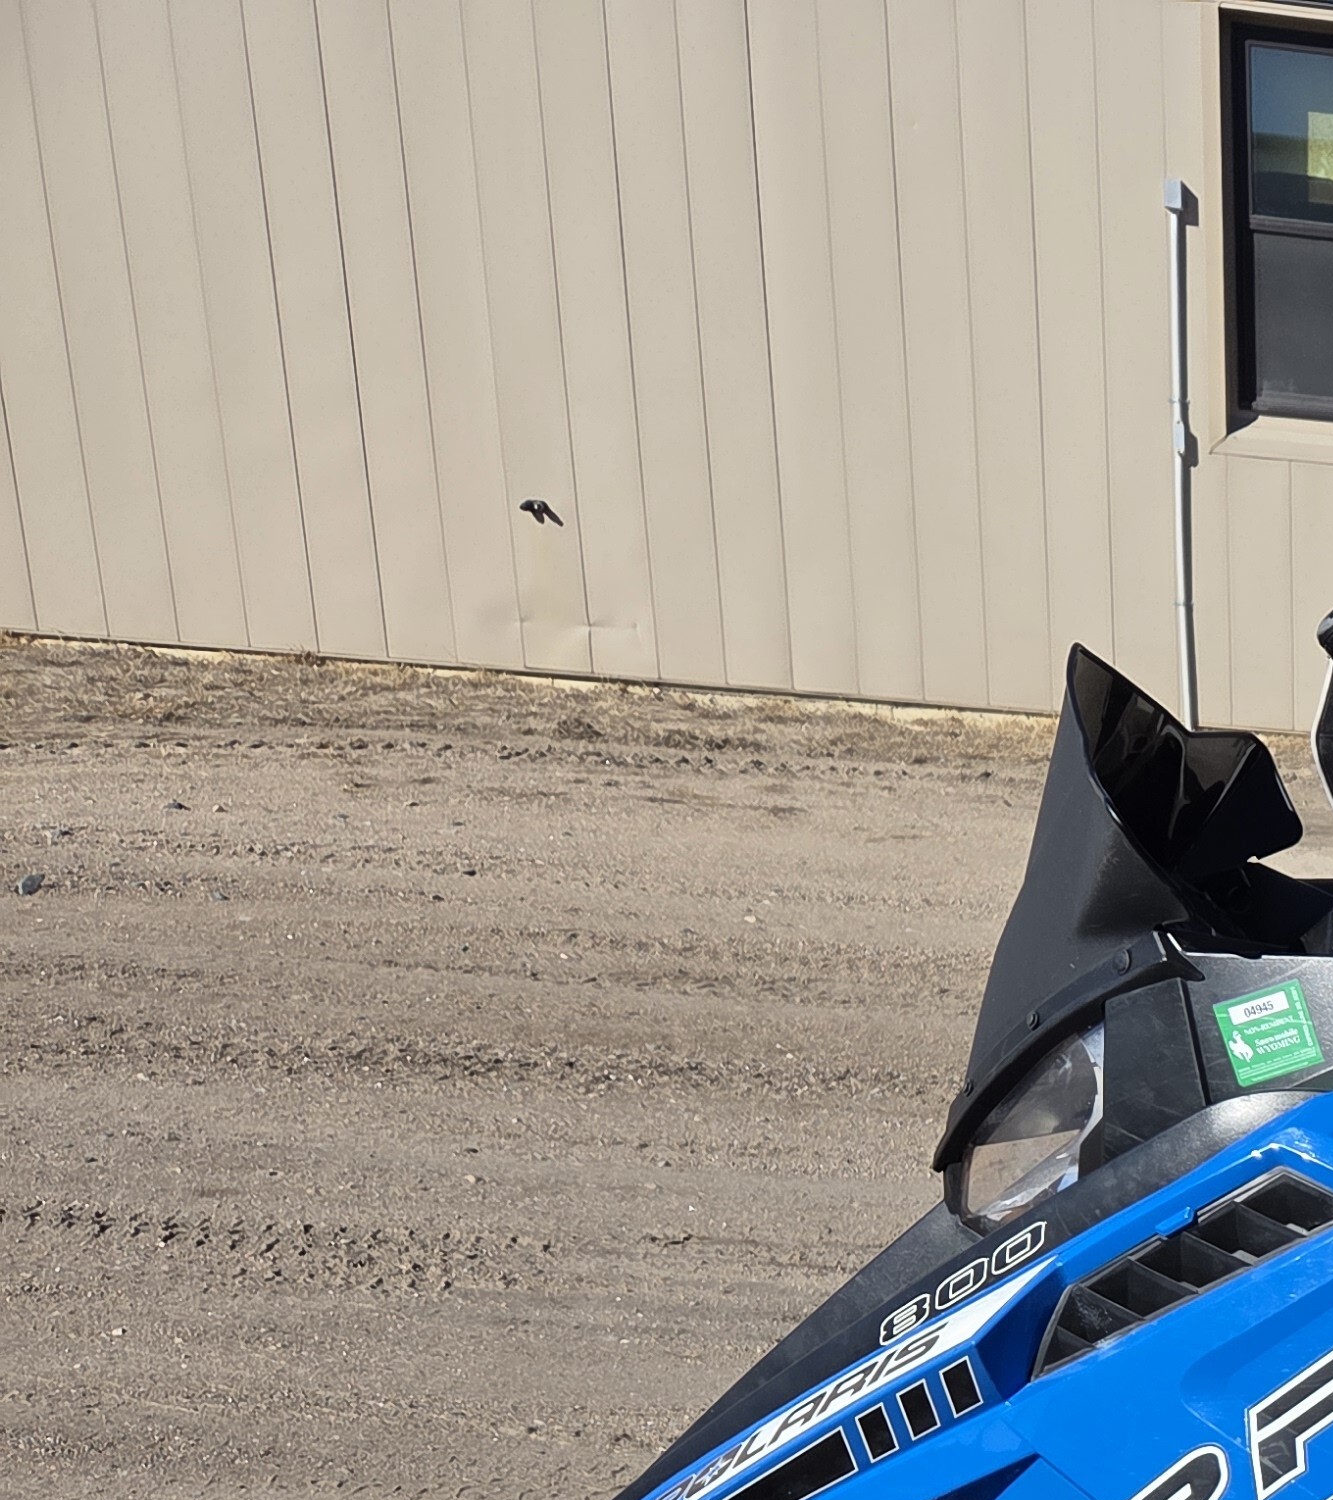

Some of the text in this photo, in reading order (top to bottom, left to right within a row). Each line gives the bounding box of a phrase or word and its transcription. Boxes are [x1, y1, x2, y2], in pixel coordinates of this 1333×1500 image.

[1243, 1000, 1274, 1018] 04945
[1255, 1035, 1301, 1055] WYOMING
[879, 1220, 1047, 1347] 800
